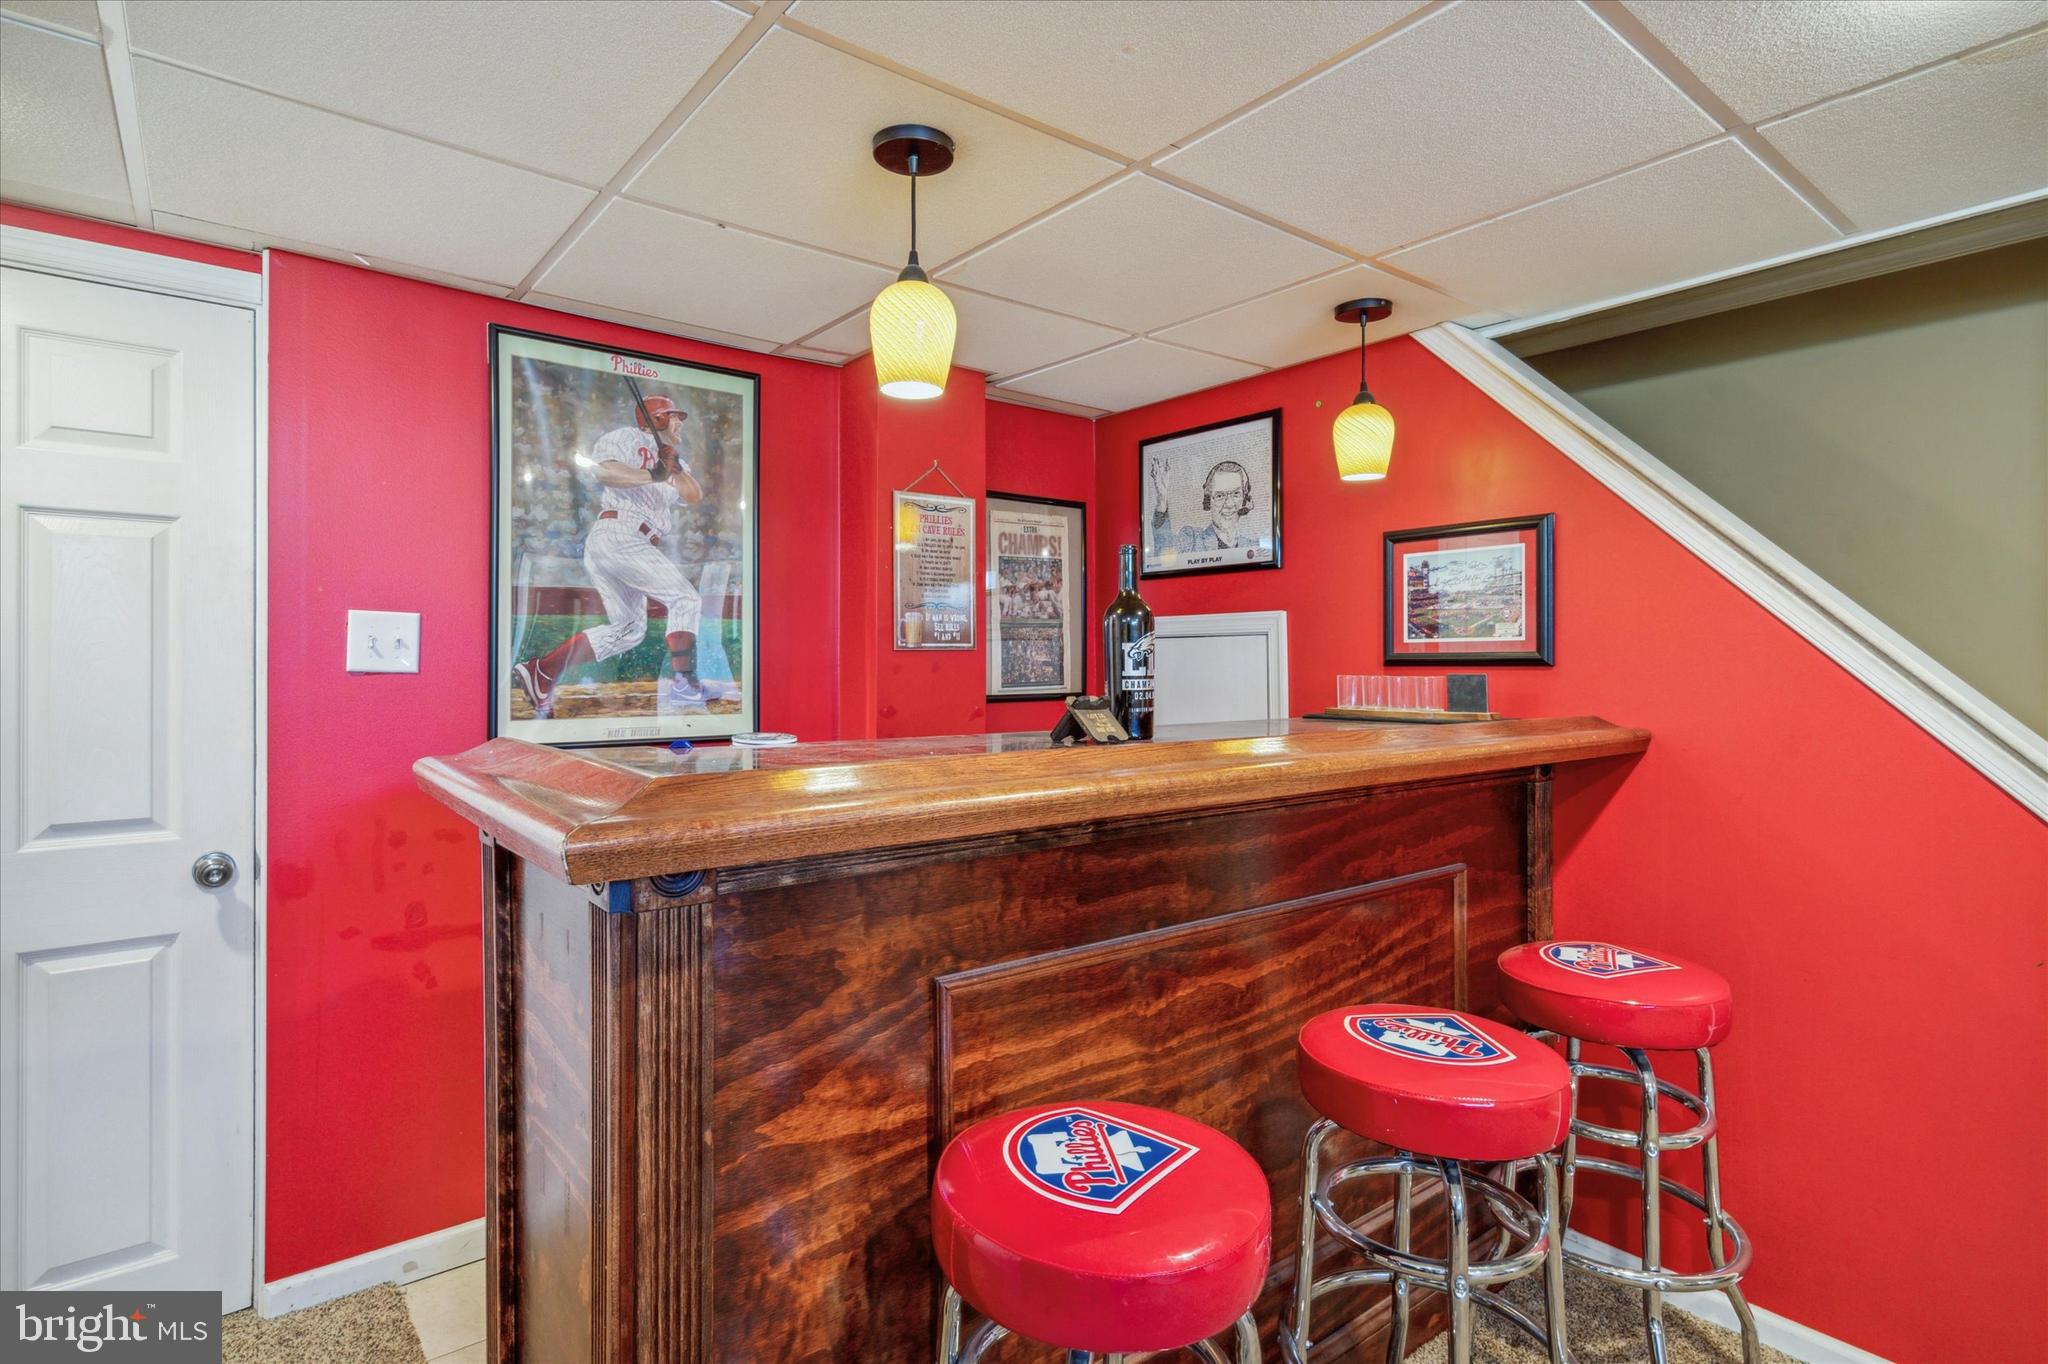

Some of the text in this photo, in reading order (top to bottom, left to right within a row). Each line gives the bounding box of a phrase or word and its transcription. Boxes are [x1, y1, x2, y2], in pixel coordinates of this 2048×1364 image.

[611, 353, 658, 378] Phillies
[920, 514, 953, 526] PHILLIES
[922, 525, 941, 535] CAVE
[943, 526, 966, 537] RULES
[1023, 526, 1038, 534] EXTRA
[998, 532, 1062, 557] CHAMPS!
[1373, 1018, 1484, 1057] Phillies
[1063, 1119, 1118, 1193] Phillies
